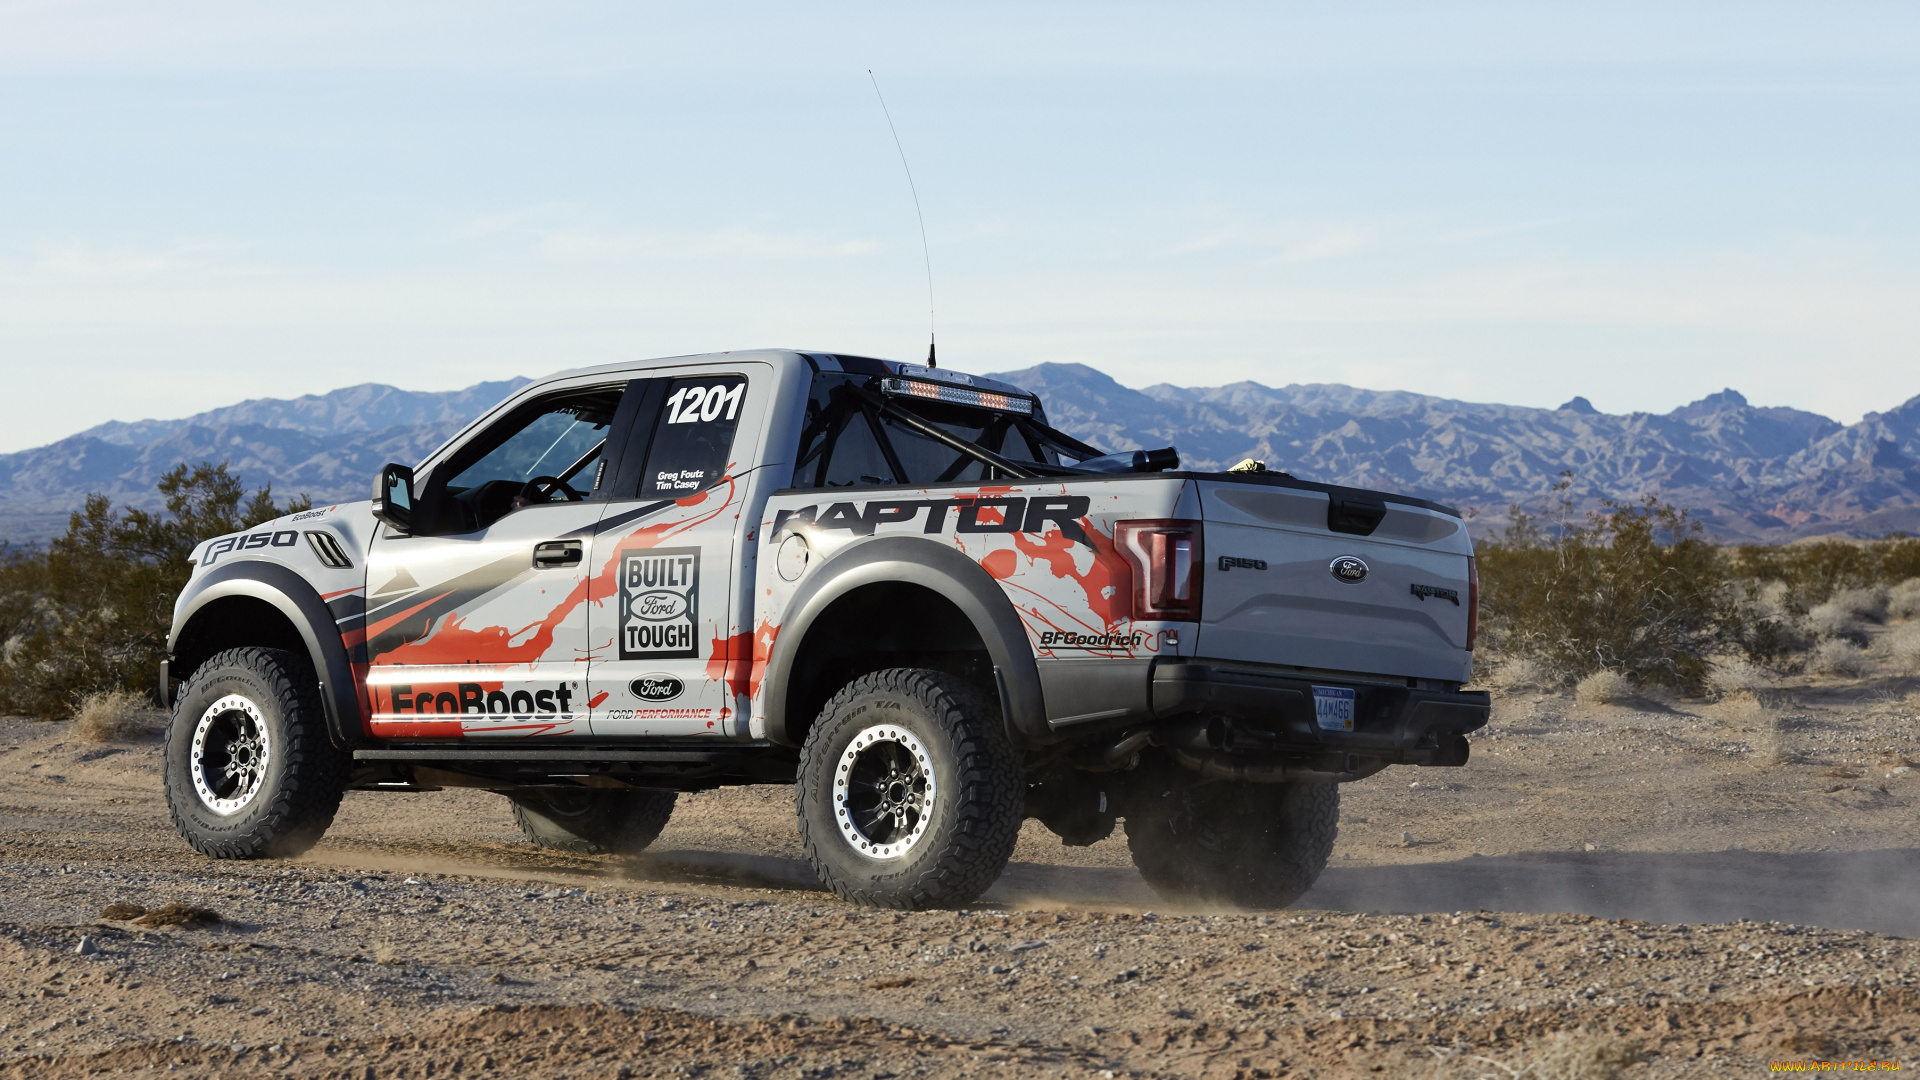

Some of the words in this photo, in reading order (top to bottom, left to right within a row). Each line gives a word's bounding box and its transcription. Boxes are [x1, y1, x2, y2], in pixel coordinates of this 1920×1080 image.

[667, 383, 745, 424] 1201
[657, 472, 678, 481] Greg
[680, 470, 704, 479] Foutz
[656, 481, 672, 490] Tim
[674, 480, 700, 490] Casey
[291, 509, 327, 522] EcoBoost
[769, 496, 1101, 555] RAPTOR
[201, 530, 299, 567] F150
[1218, 555, 1268, 571] F150
[1340, 561, 1363, 578] Ford
[628, 558, 692, 588] BUILT
[1411, 583, 1460, 606] RAPTOR
[641, 595, 676, 615] Ford
[627, 625, 690, 648] TOUGH
[1041, 631, 1142, 646] BFGoodrich
[641, 677, 673, 696] Ford
[1318, 688, 1343, 697] MICHIGAN
[606, 710, 633, 719] FORD
[634, 709, 712, 719] PERFORMANCE
